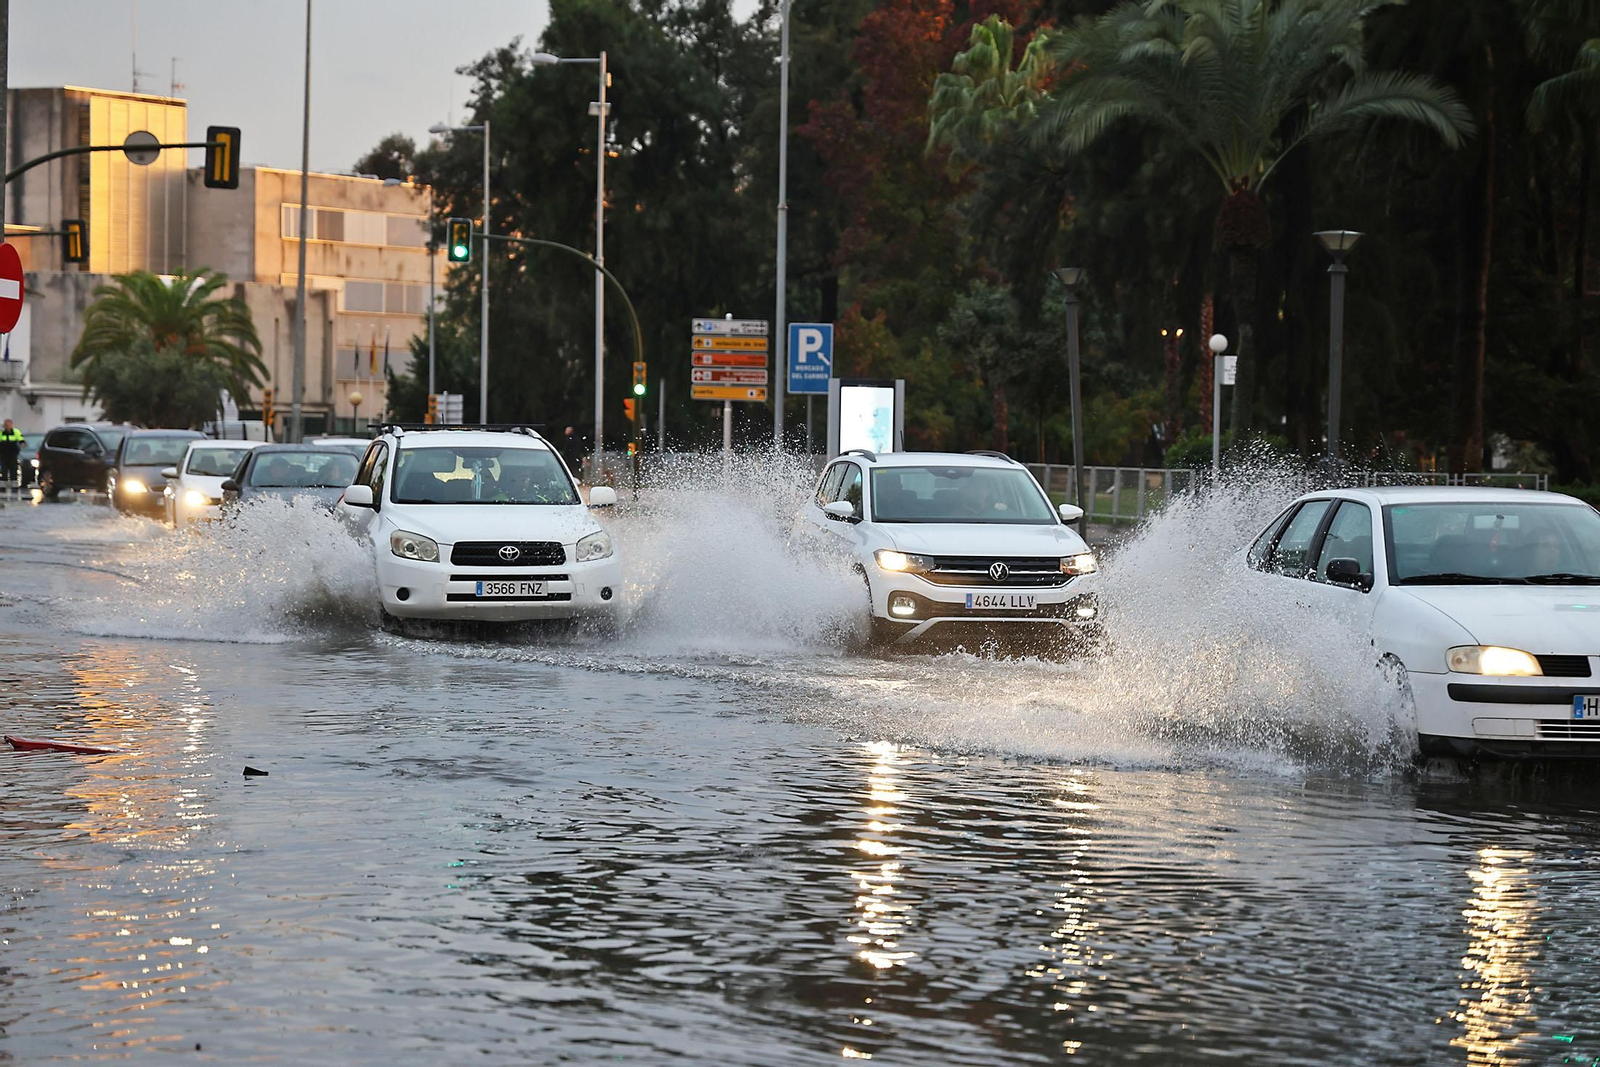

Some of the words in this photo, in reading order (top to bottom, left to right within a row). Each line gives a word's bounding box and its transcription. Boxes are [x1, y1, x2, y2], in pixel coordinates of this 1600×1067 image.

[798, 328, 823, 363] P
[795, 364, 825, 372] MERCADO
[486, 583, 515, 594] 3566
[520, 583, 542, 594] FNZ
[975, 595, 1006, 607] 4644
[1011, 595, 1034, 607] LLV
[1588, 698, 1598, 716] H
